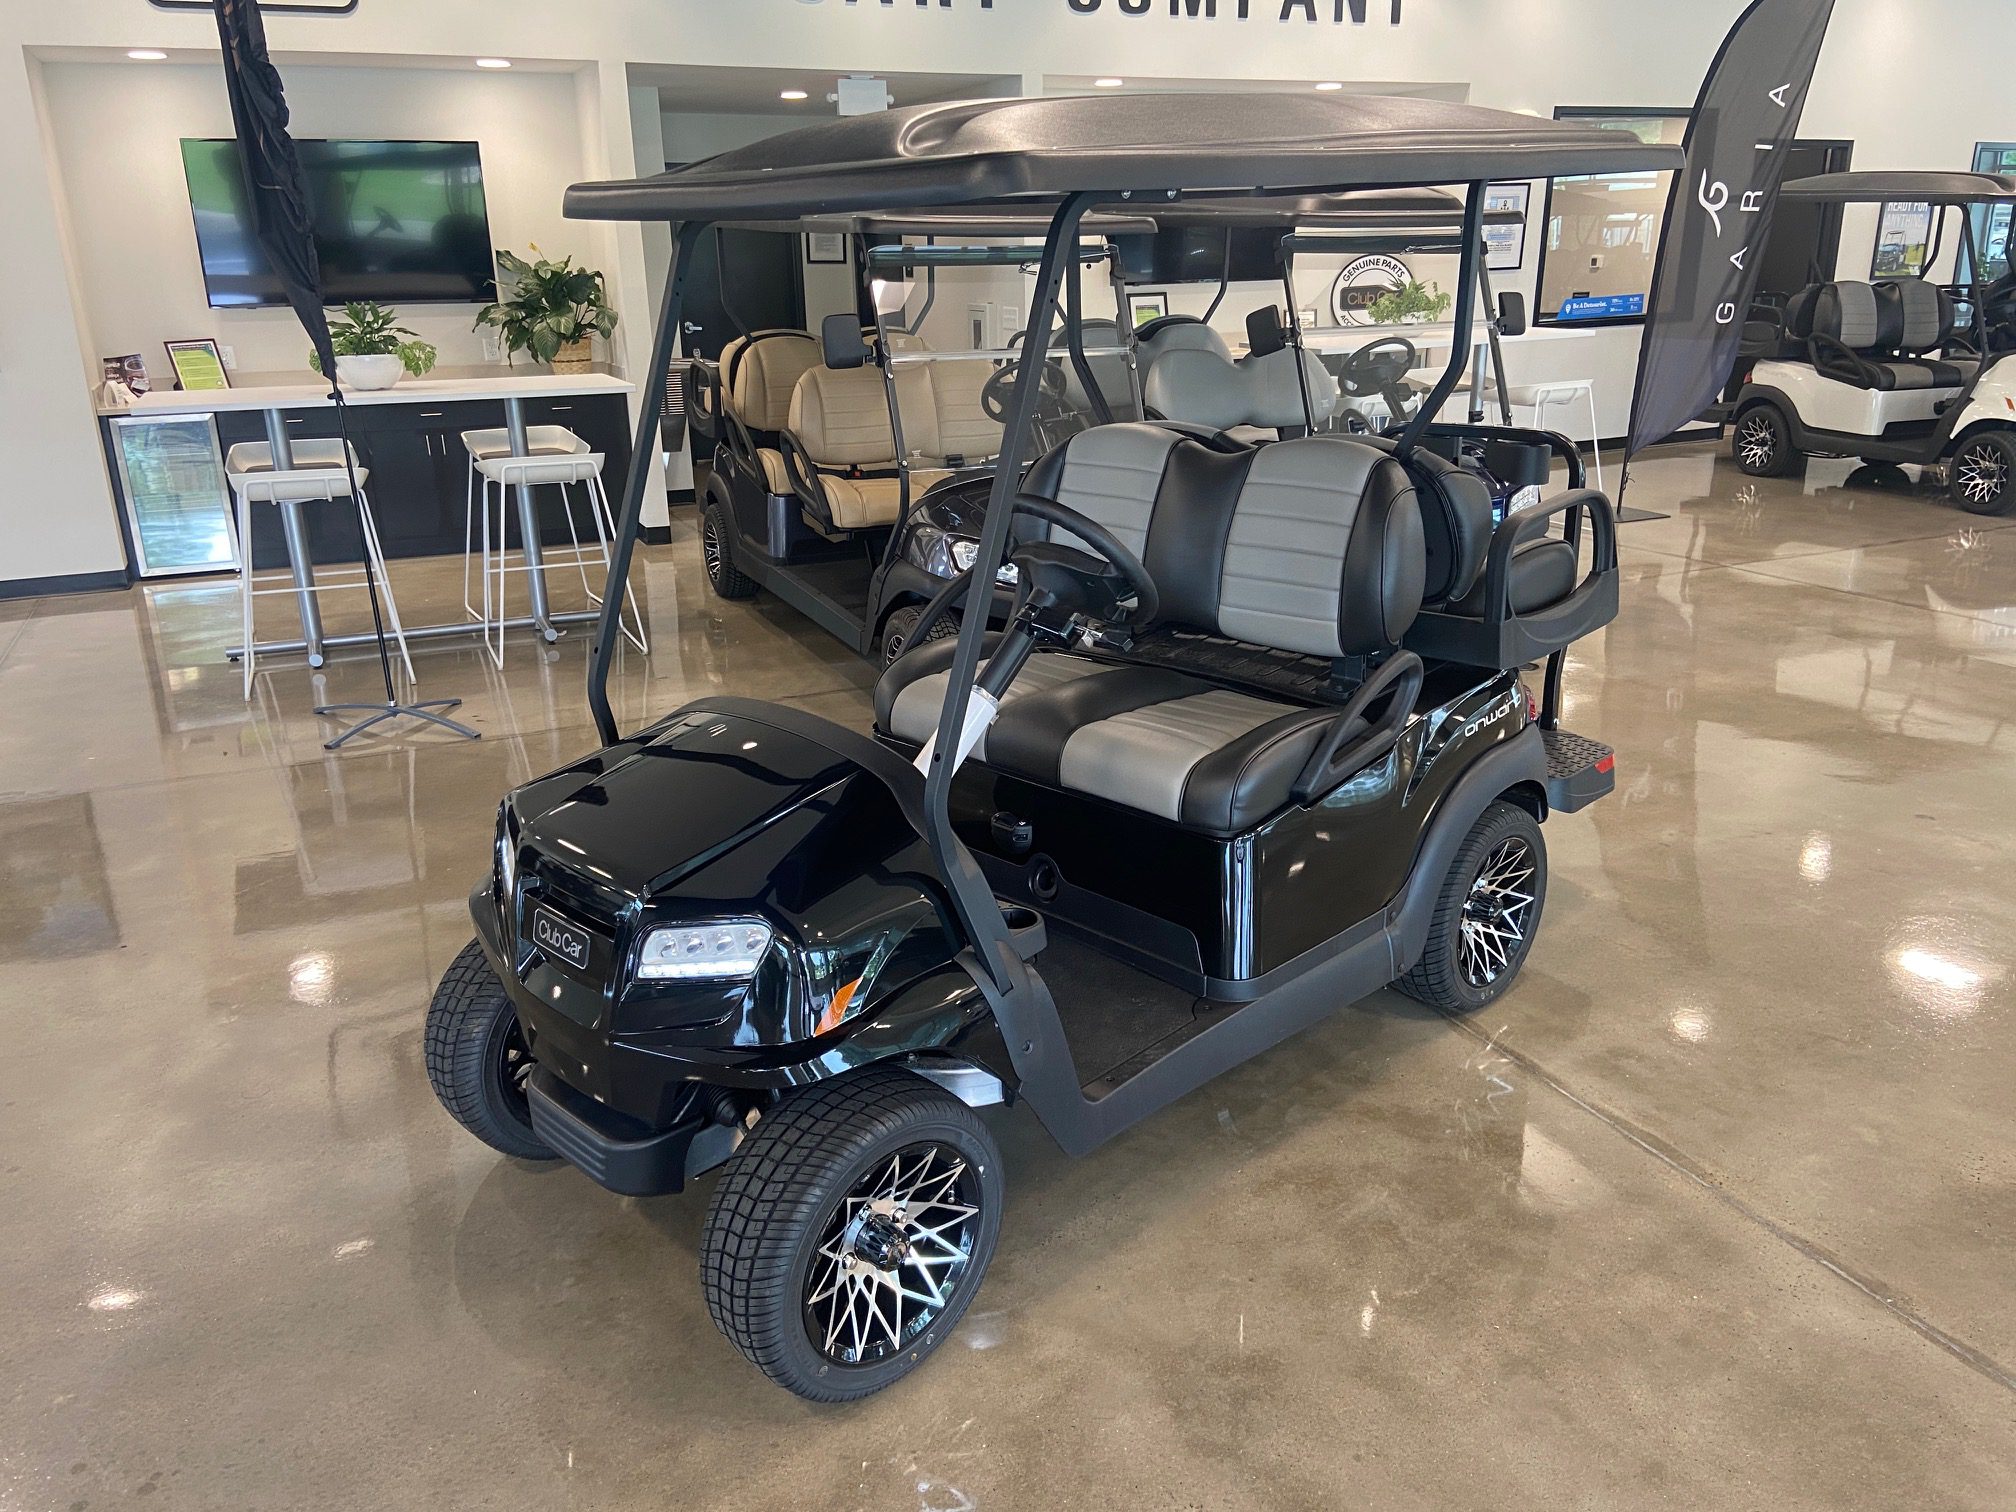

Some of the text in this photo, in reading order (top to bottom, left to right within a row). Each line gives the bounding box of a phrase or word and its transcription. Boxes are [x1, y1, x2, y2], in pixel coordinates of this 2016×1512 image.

[1715, 83, 1791, 324] GARIA
[1343, 258, 1405, 282] GENUINE PARTS
[1347, 292, 1375, 305] Club
[539, 920, 582, 958] Club Car
